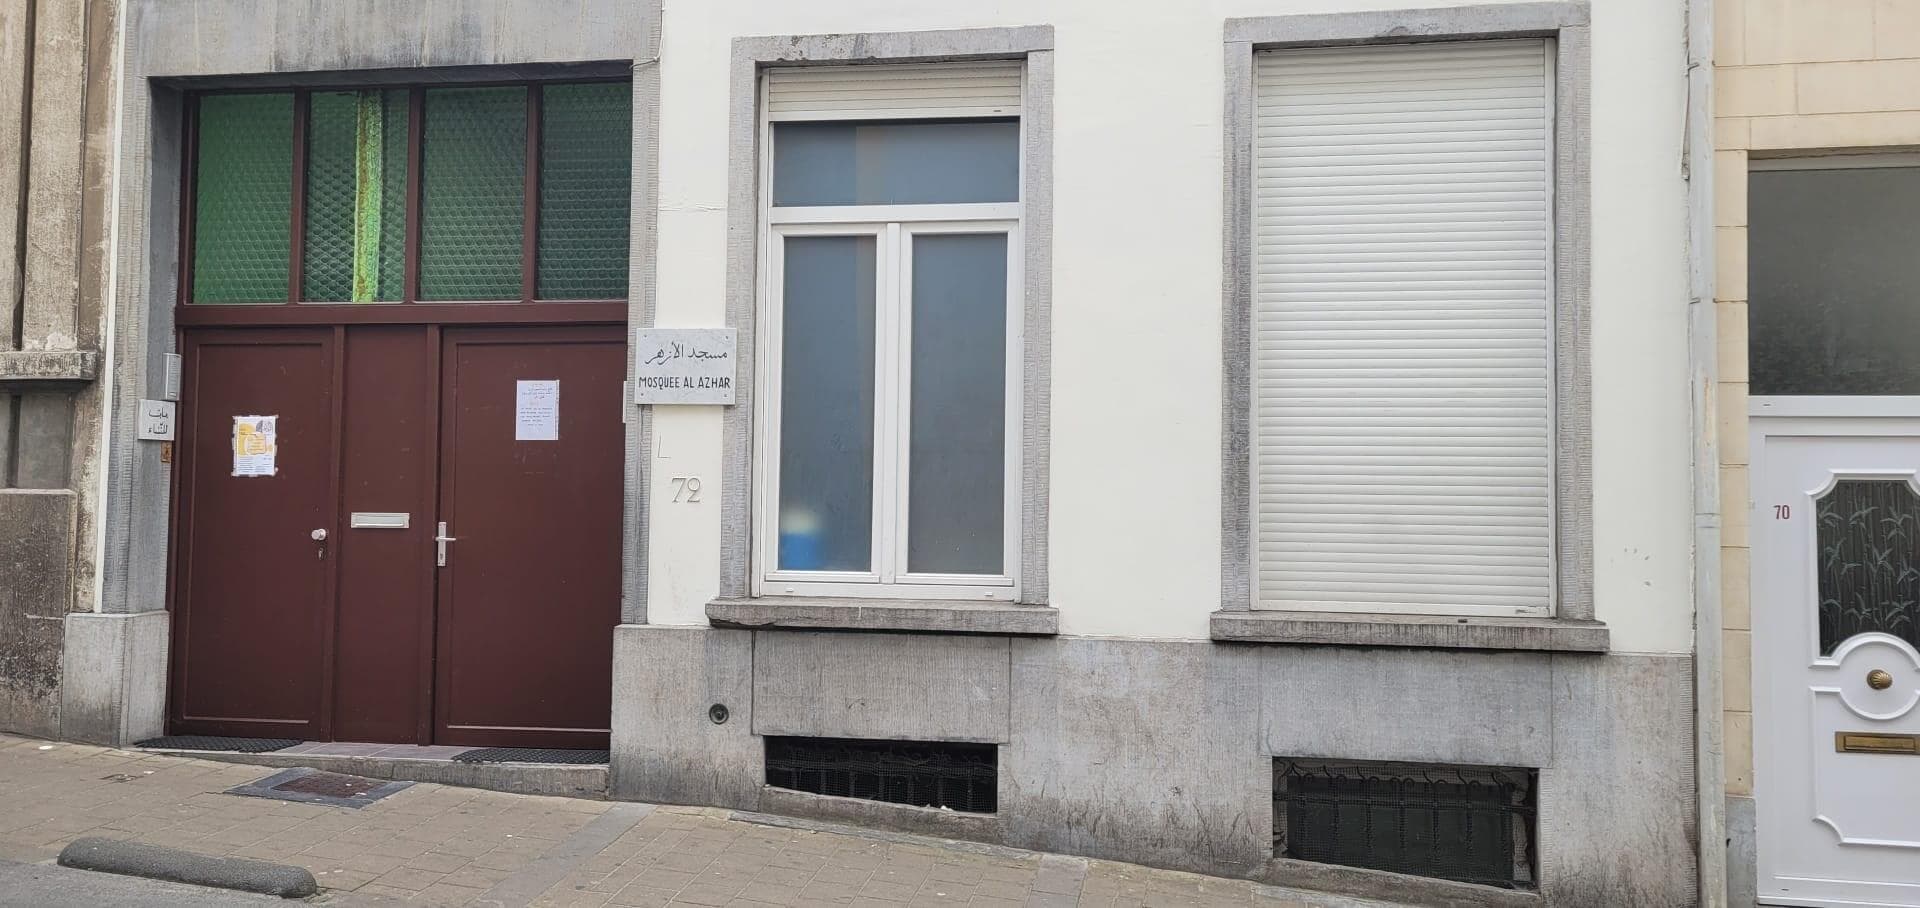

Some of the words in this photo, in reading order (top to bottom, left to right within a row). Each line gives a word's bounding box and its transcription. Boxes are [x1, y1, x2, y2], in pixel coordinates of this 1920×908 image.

[644, 341, 684, 366] الأزهر
[687, 347, 728, 362] مسجد
[638, 376, 681, 390] MOSQUEE
[683, 376, 695, 389] AL
[697, 376, 731, 389] AZHAR
[671, 477, 701, 503] 72
[1773, 504, 1790, 520] 70
